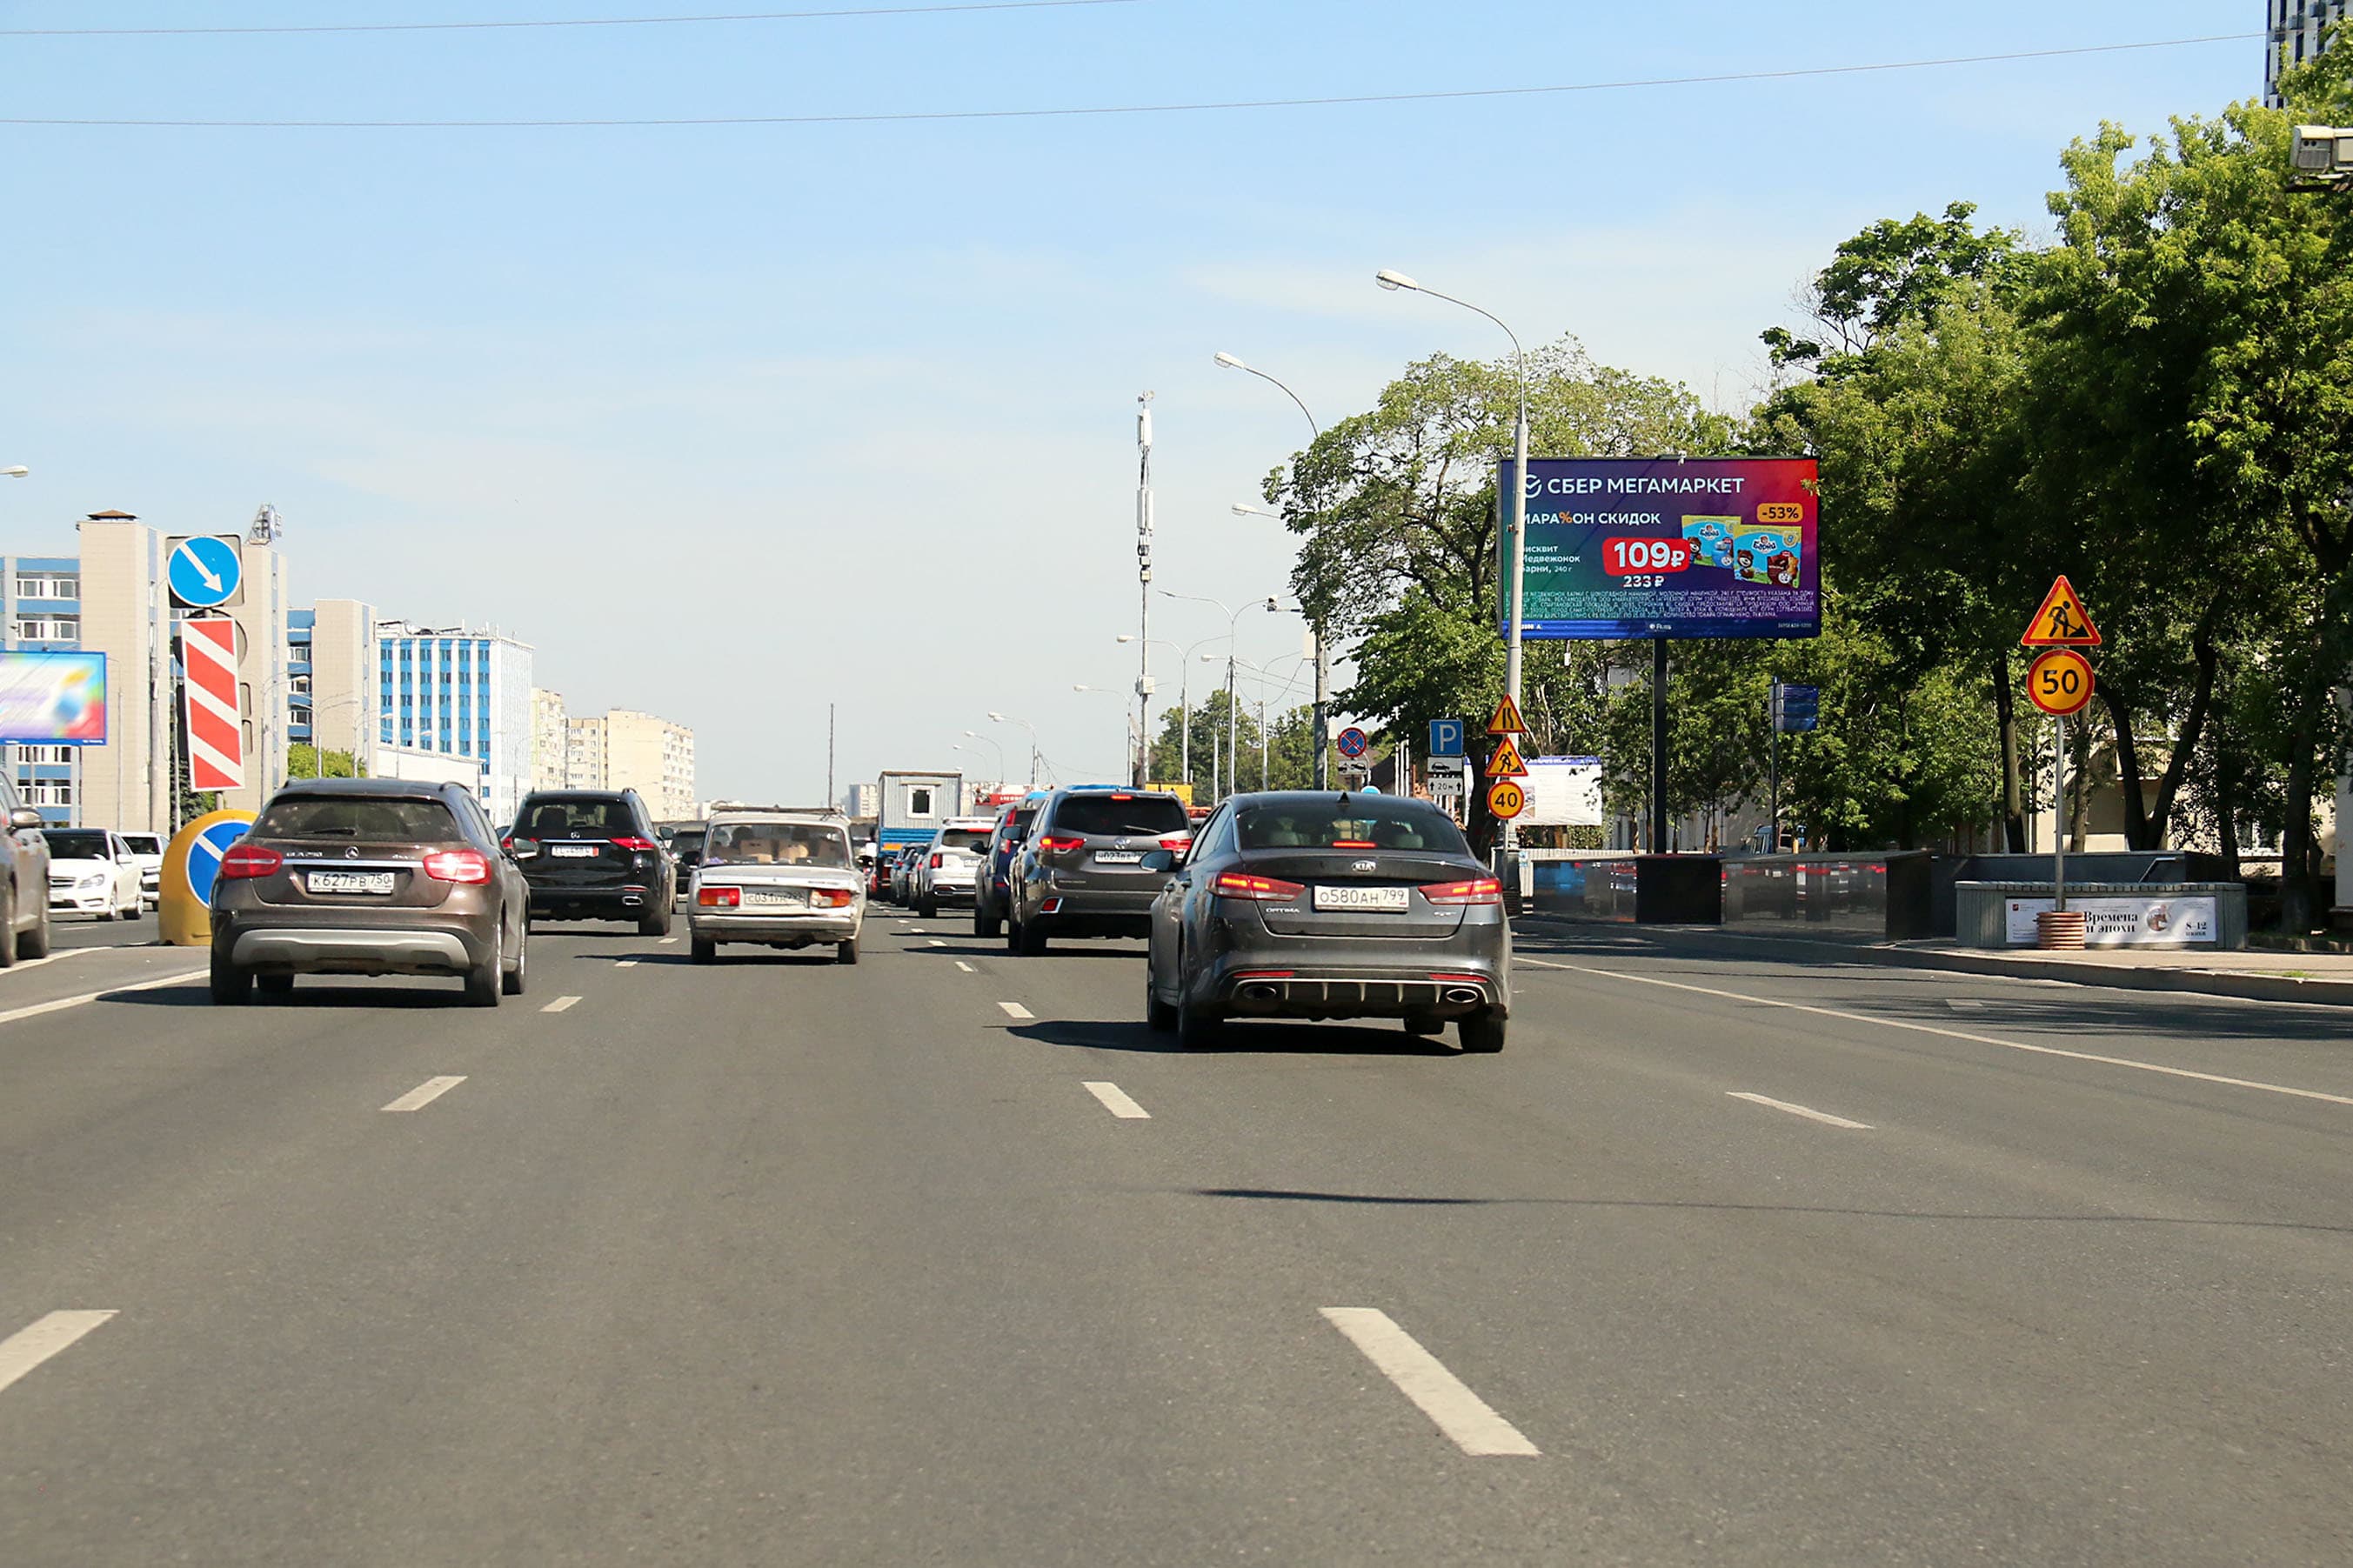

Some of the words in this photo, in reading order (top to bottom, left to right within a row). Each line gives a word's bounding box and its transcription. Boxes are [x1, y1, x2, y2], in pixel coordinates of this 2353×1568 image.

[1547, 478, 1601, 494] СБЕР
[1608, 477, 1745, 494] МЕГАМАРКЕТ
[1598, 512, 1661, 524] СКИДОК
[1761, 507, 1799, 519] -53%
[1523, 565, 1552, 574] арни,
[2042, 670, 2079, 695] 50
[1439, 724, 1457, 751] P
[1494, 792, 1518, 808] 40
[1320, 889, 1379, 904] О580АН
[2083, 911, 2138, 925] Времена
[2098, 924, 2136, 933] эпохи
